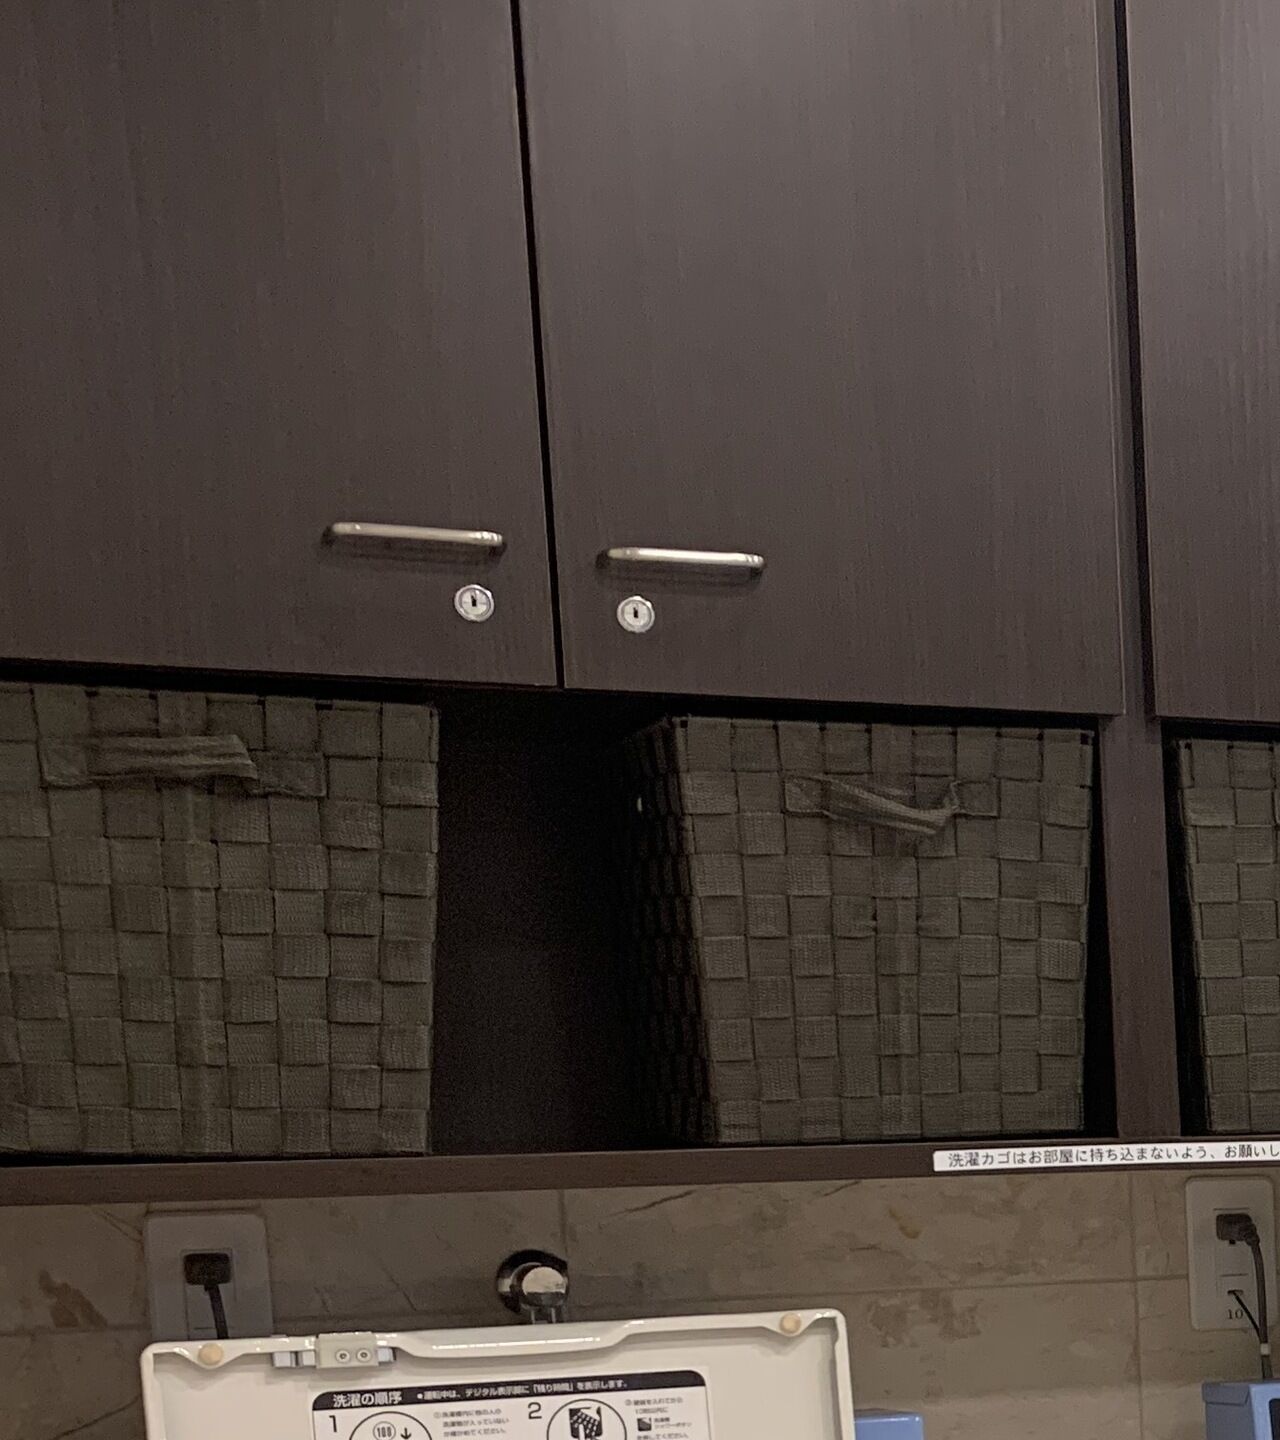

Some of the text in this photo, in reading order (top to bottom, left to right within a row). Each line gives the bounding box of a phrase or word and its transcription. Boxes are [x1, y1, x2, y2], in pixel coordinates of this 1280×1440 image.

[332, 1392, 403, 1408] 洗濯の順序
[328, 1402, 543, 1434] 1 2
